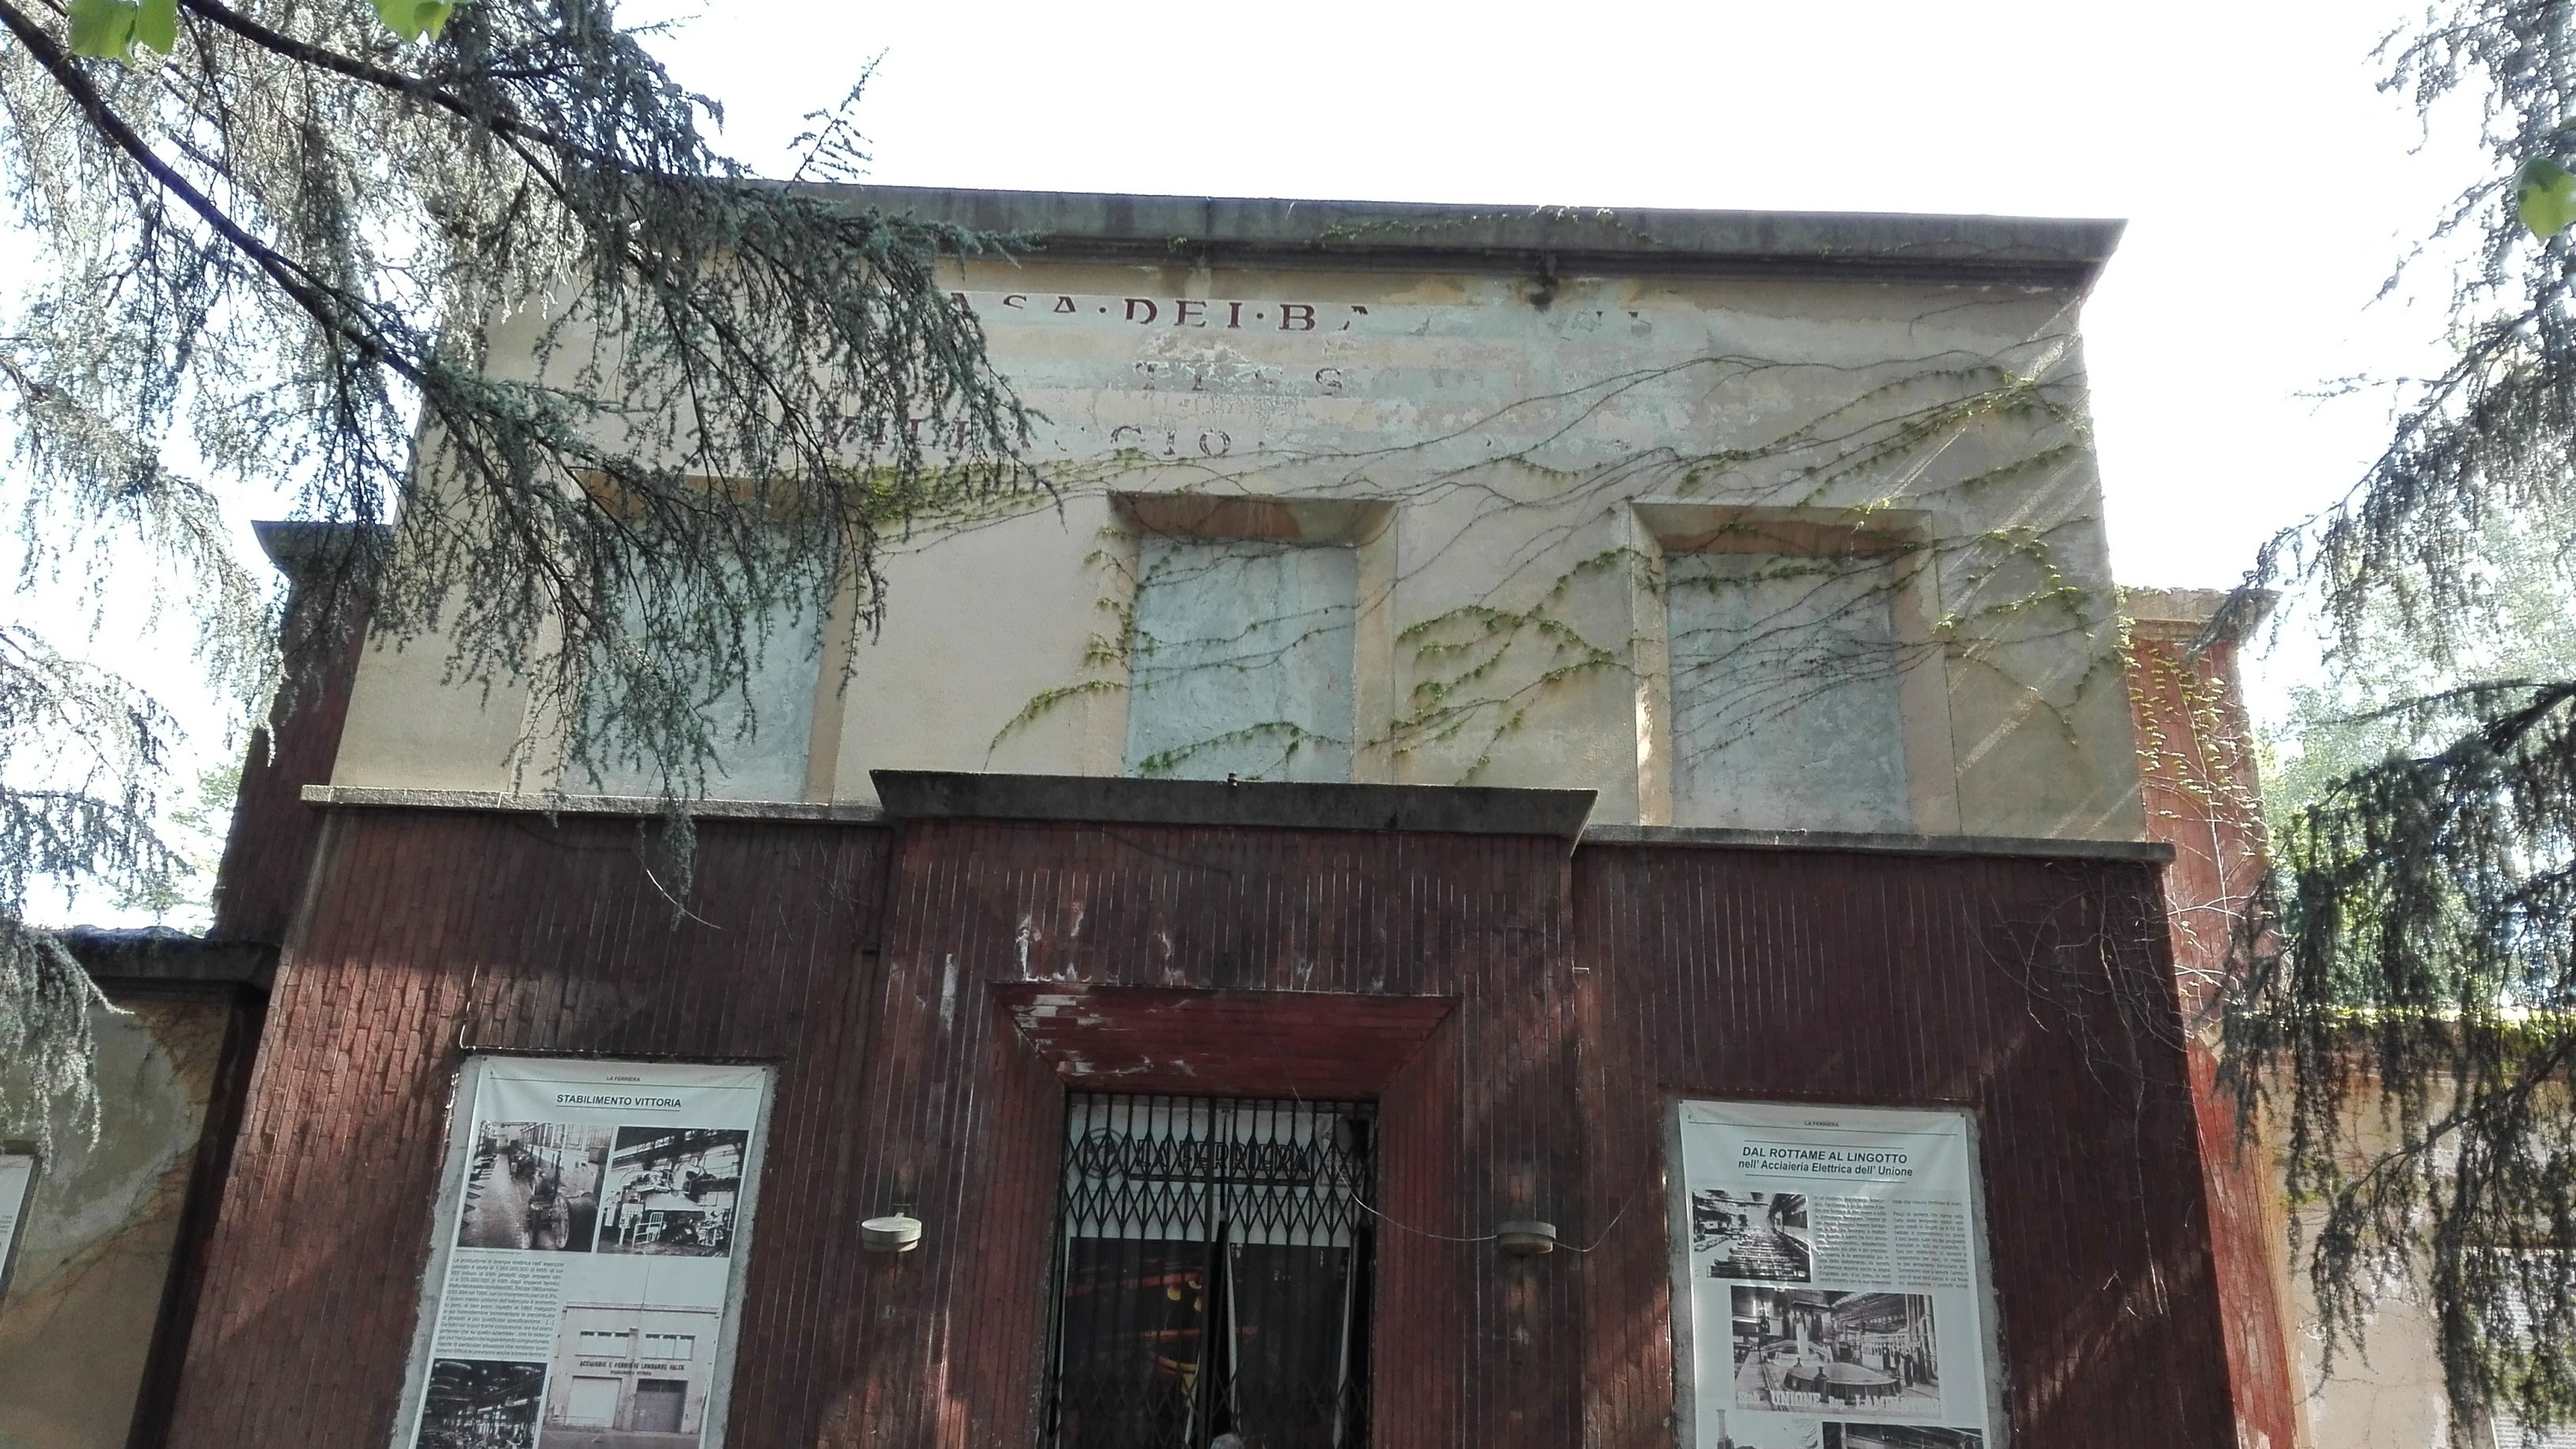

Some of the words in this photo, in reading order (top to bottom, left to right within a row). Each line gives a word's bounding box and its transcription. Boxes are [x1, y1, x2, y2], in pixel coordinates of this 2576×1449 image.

[556, 1095, 632, 1106] STABILIMENTO
[635, 1098, 681, 1107] VITTORIA
[1743, 1147, 1765, 1157] DAL
[1769, 1148, 1825, 1160] ROTTAME
[1828, 1151, 1844, 1161] AL
[1848, 1152, 1908, 1164] LINGOTTO
[1761, 1160, 1809, 1172] Acciaieria
[1812, 1163, 1852, 1174] Elettrica
[1878, 1166, 1913, 1176] Unione
